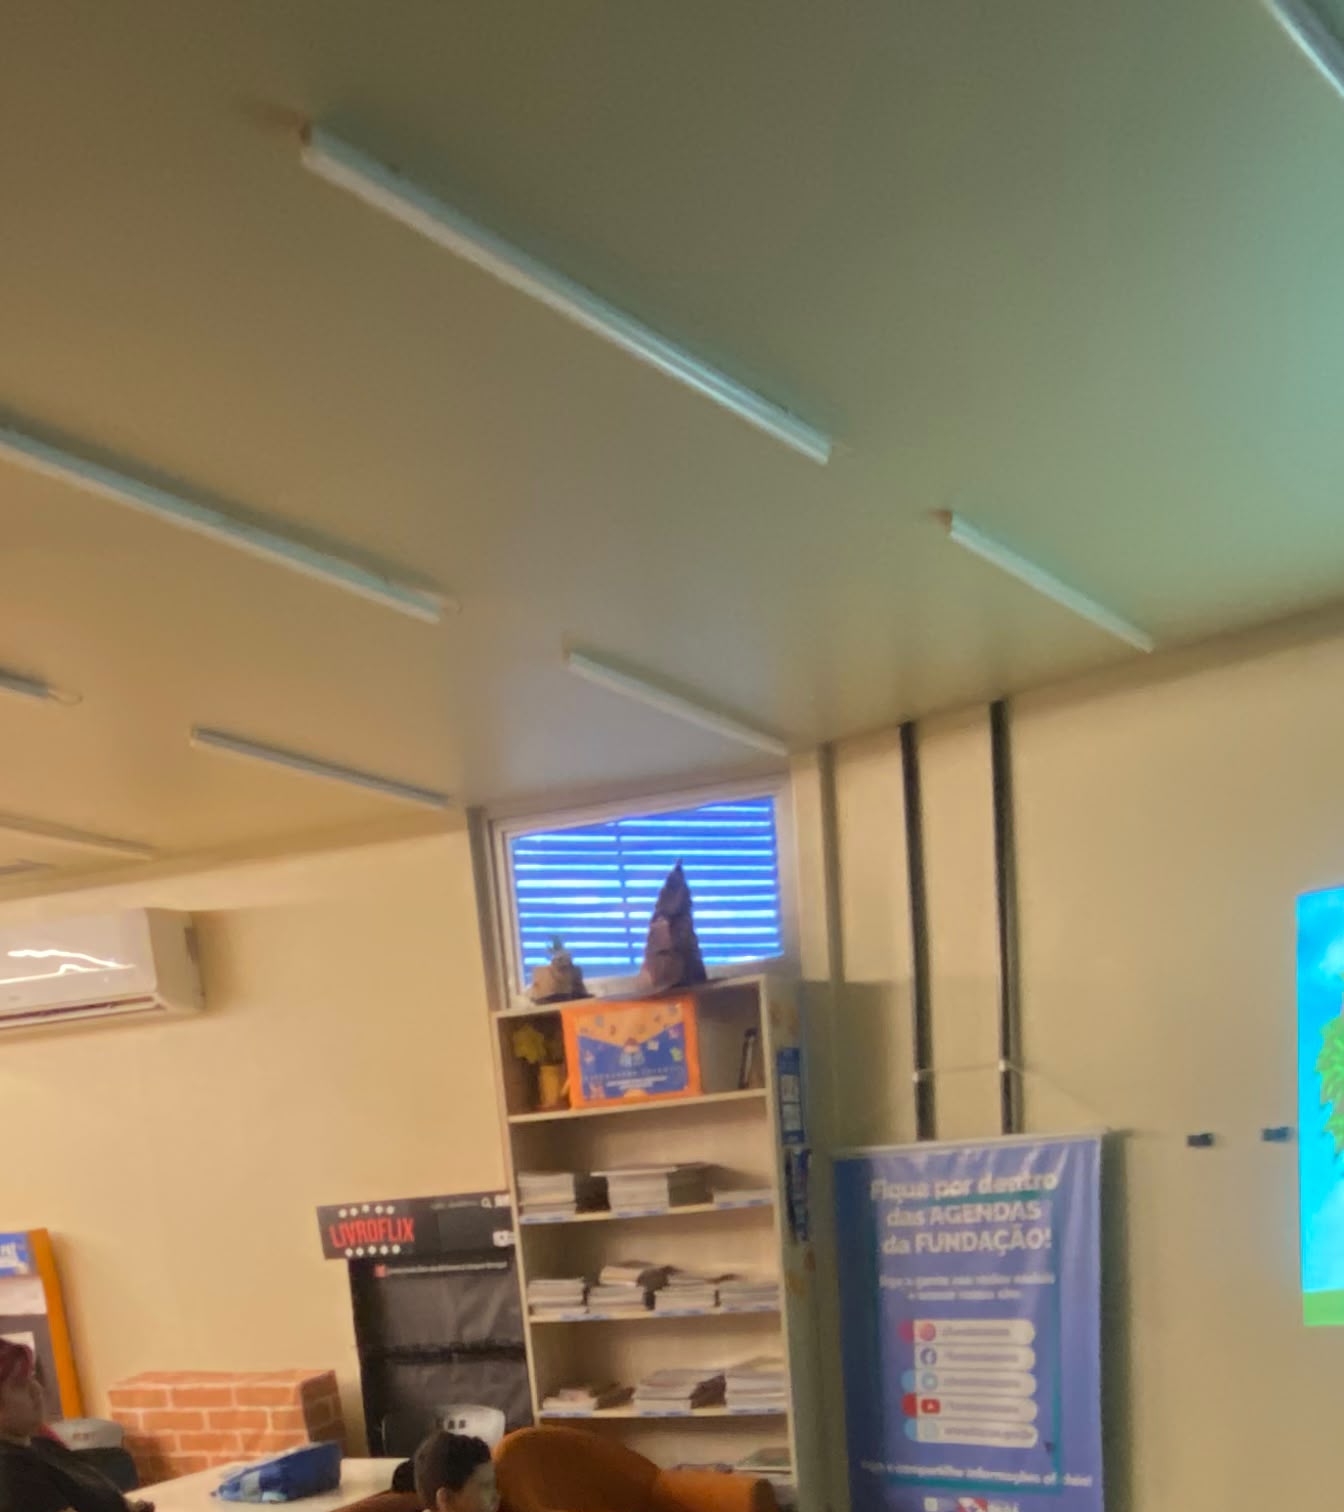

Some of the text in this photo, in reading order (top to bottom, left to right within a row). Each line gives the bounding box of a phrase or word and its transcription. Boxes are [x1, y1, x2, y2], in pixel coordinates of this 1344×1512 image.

[871, 1172, 1058, 1204] Fique por dentro
[887, 1201, 1042, 1227] das AGENDAS
[328, 1217, 416, 1249] LIVROFLIX
[881, 1223, 1053, 1257] da FUNDAÇÃO!
